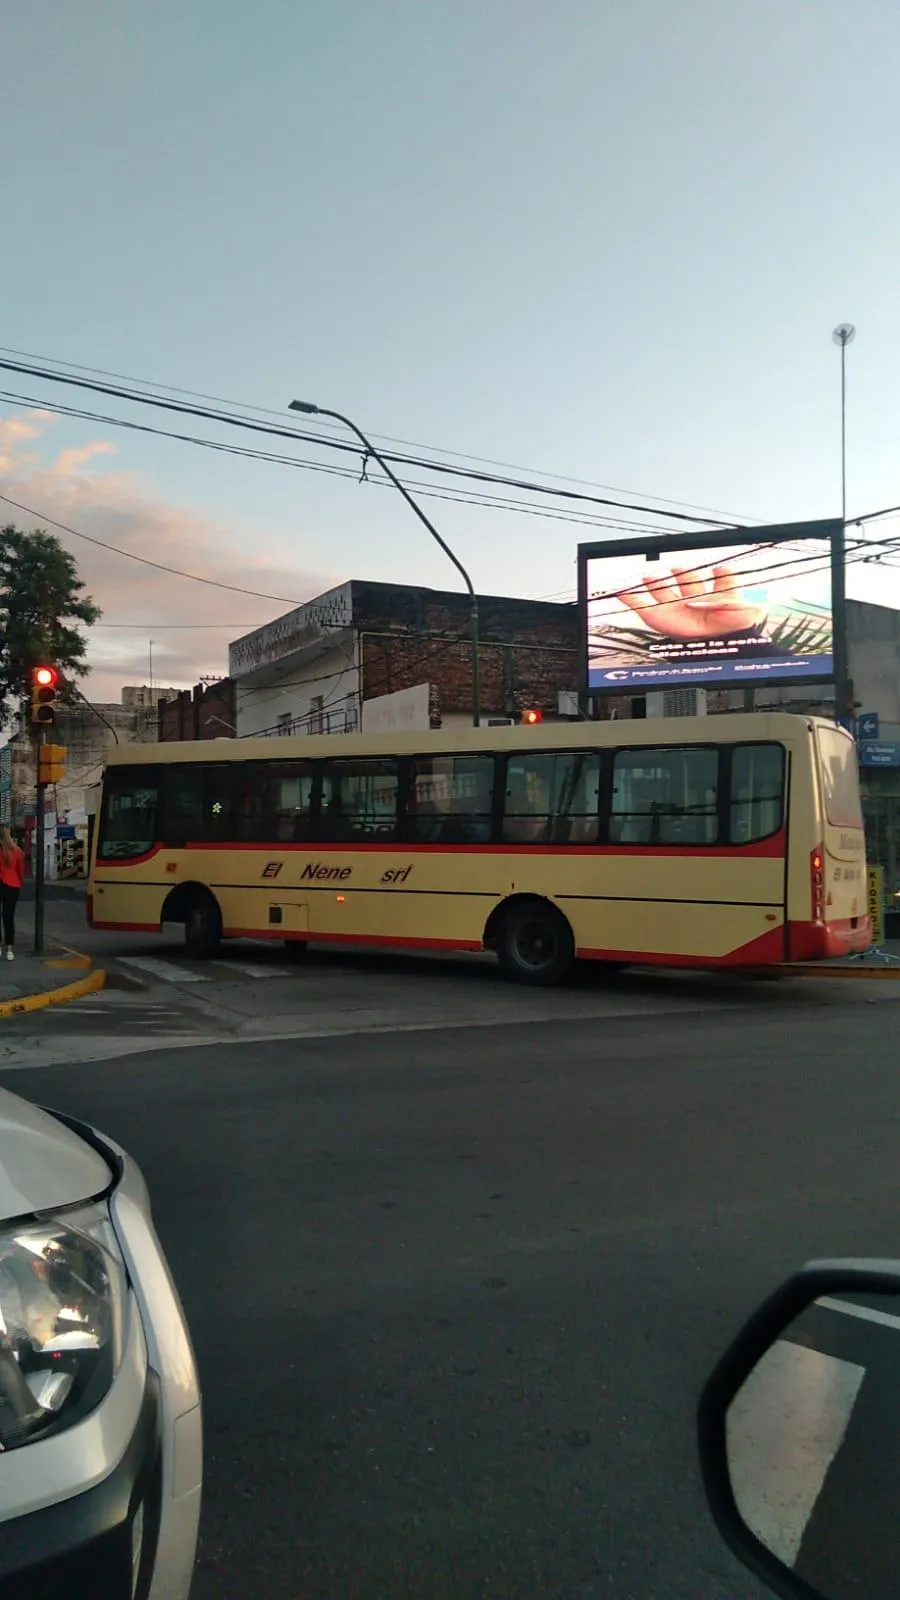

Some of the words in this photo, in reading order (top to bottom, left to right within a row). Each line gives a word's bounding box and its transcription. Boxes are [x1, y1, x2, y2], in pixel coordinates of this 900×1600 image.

[262, 861, 284, 878] El
[300, 863, 352, 880] Nene
[381, 864, 413, 882] srl
